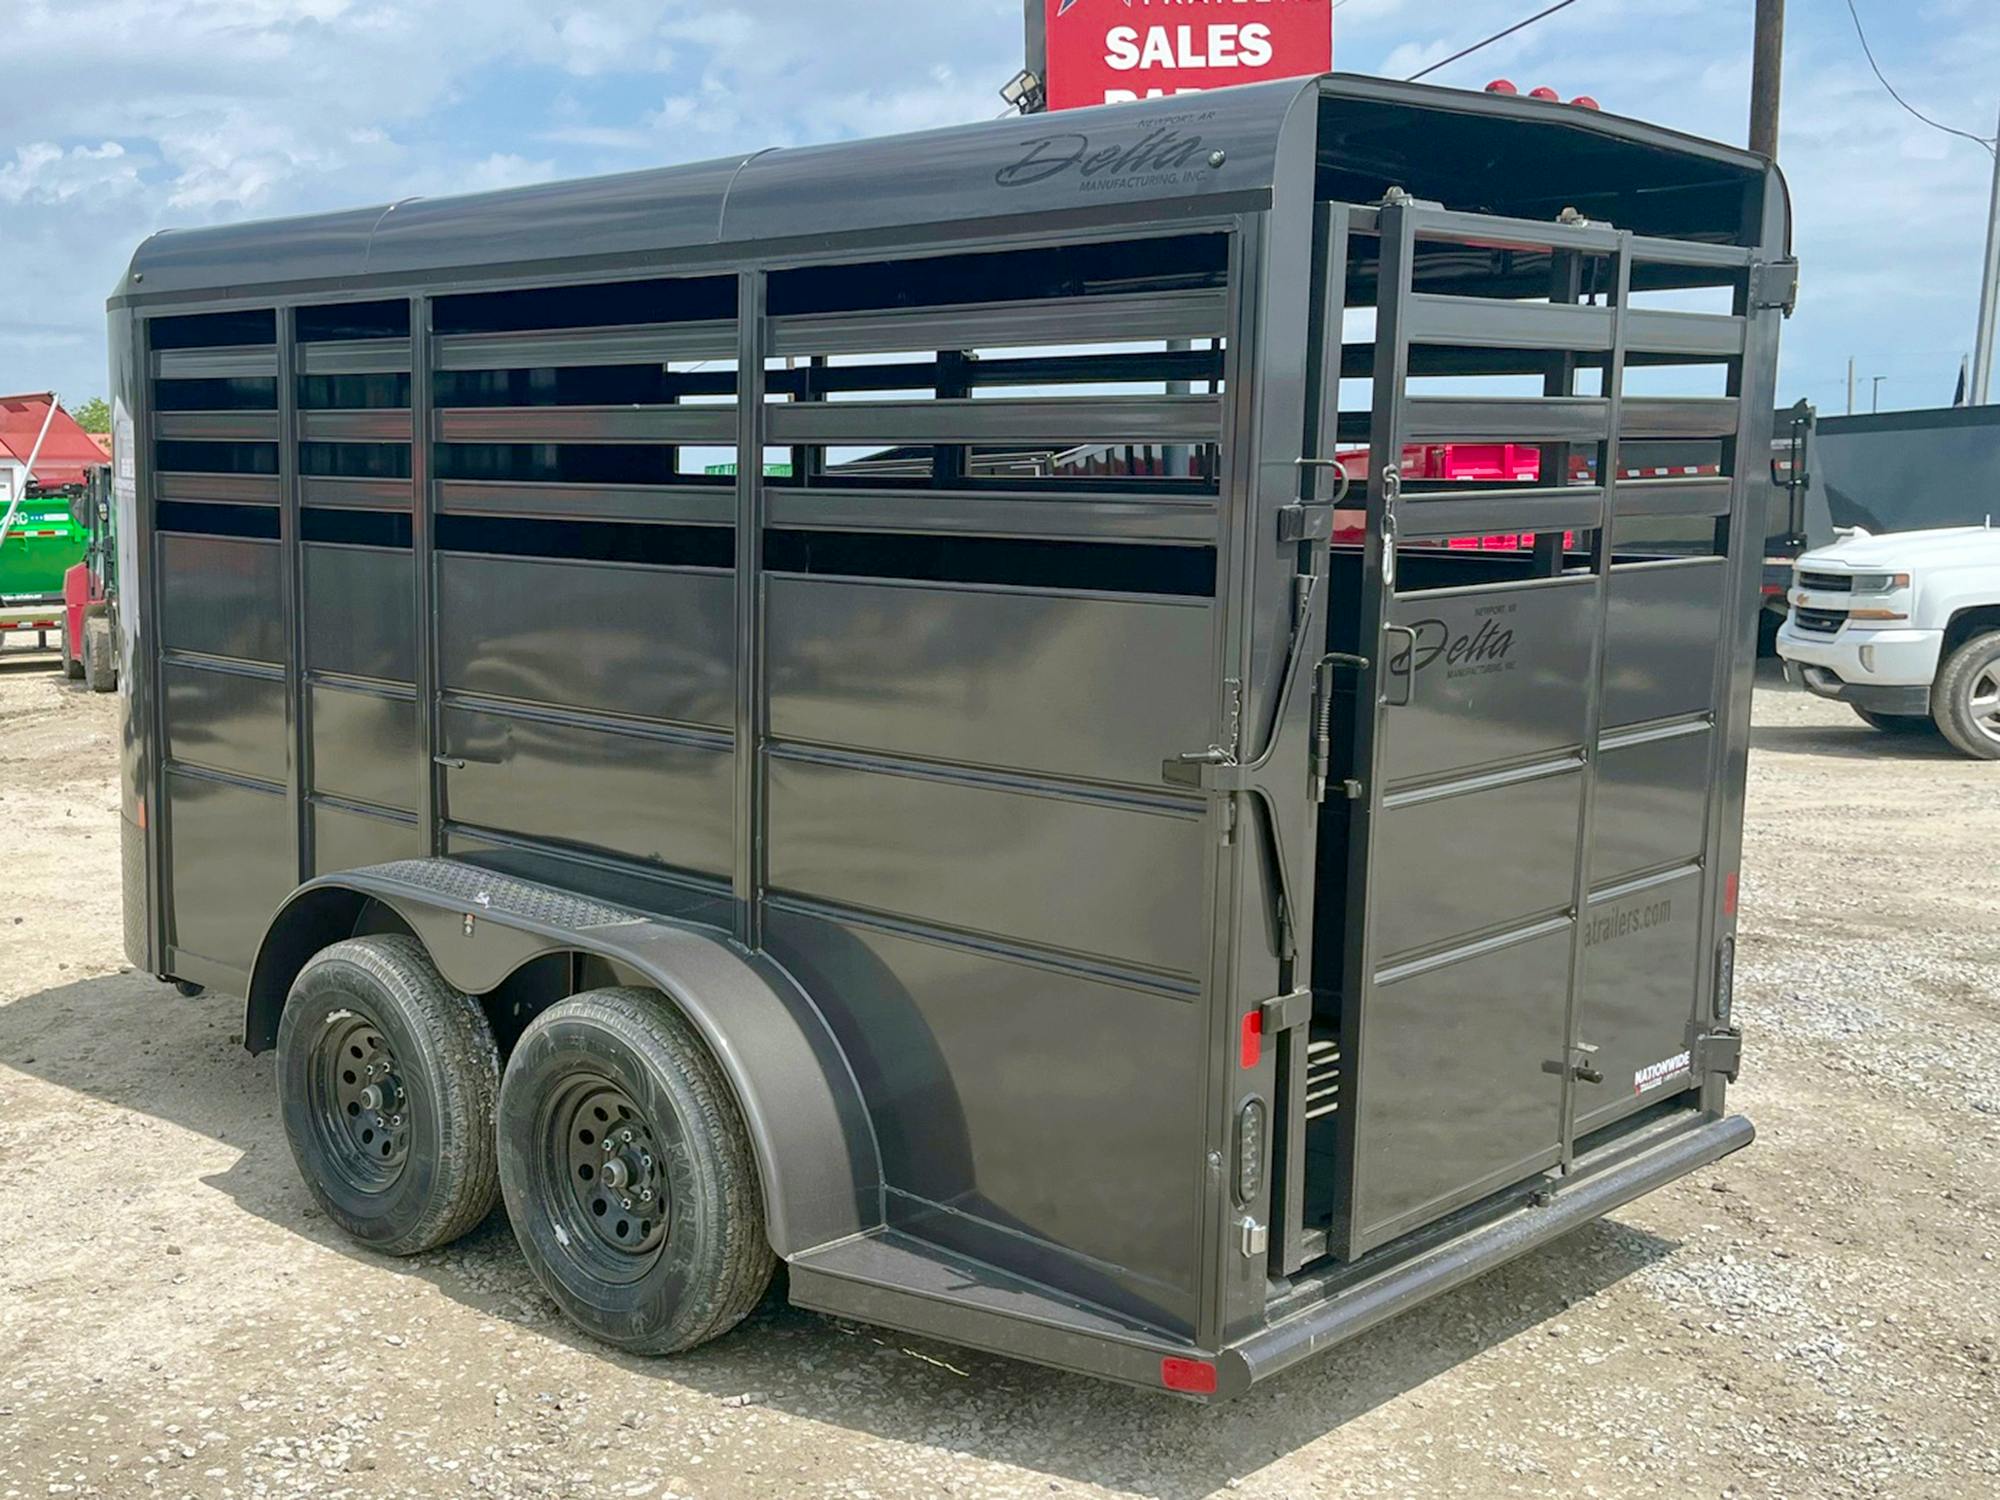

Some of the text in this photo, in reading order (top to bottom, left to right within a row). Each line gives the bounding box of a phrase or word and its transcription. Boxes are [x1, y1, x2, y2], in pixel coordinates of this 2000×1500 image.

[1104, 23, 1273, 70] SALES
[996, 127, 1206, 187] Delta
[1390, 618, 1517, 676] Delta
[1634, 1050, 1690, 1086] NATIONWIDE
